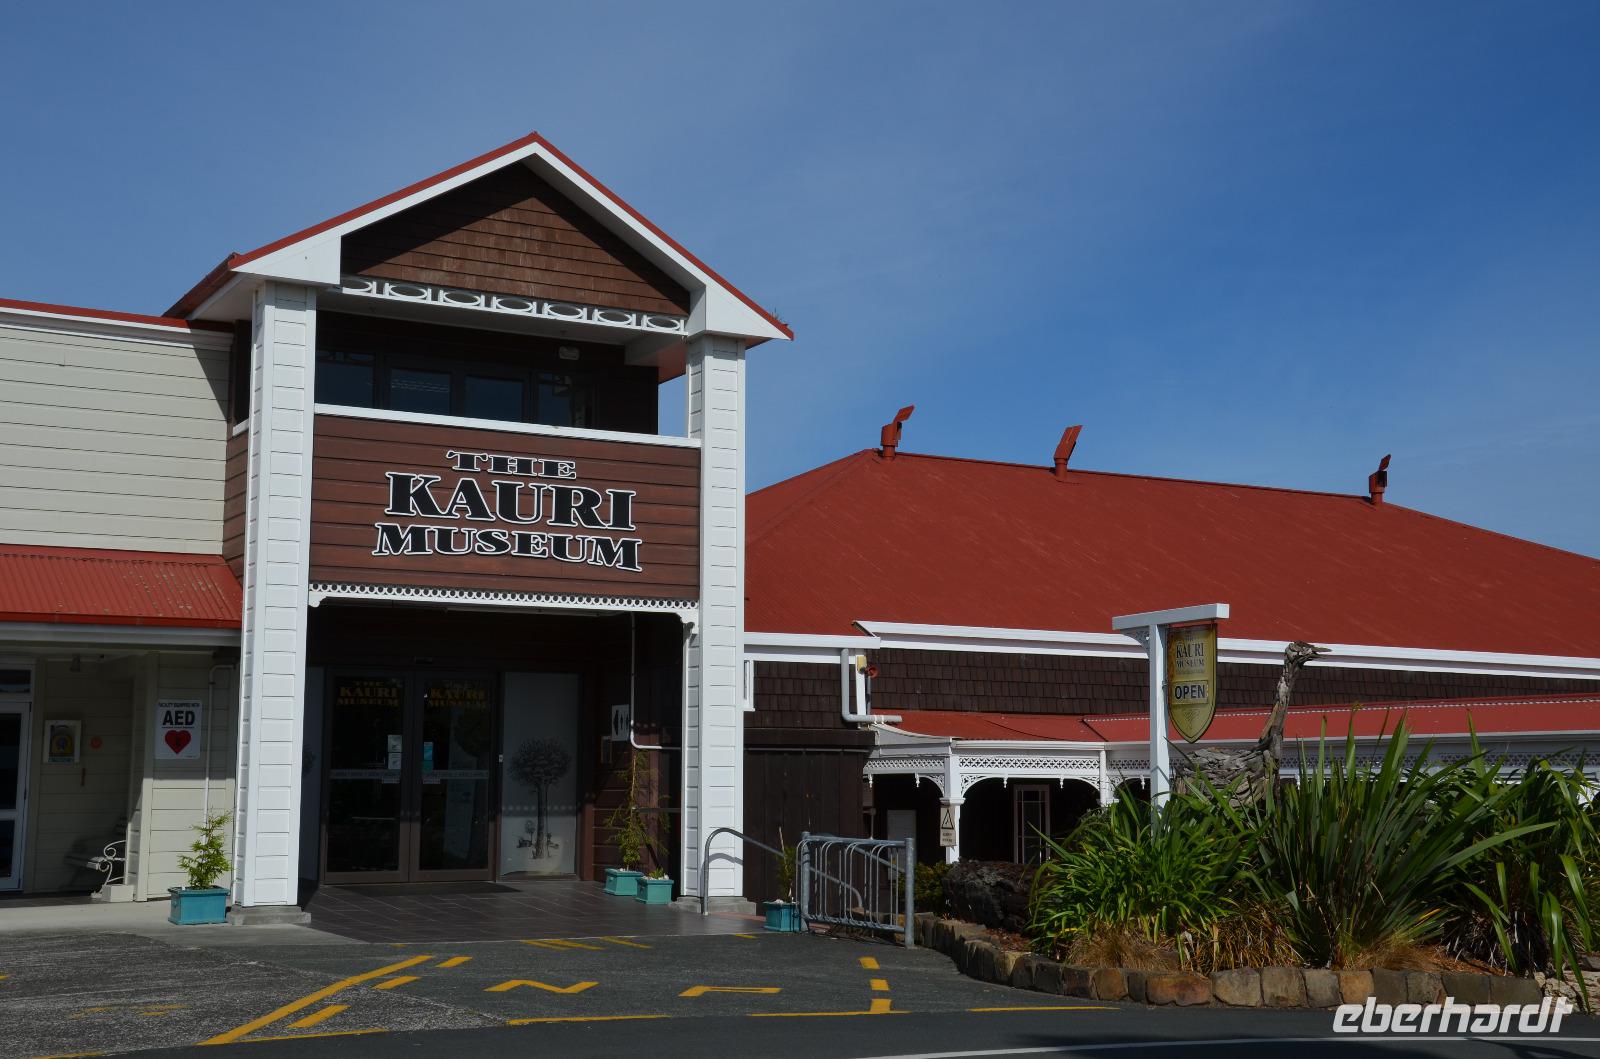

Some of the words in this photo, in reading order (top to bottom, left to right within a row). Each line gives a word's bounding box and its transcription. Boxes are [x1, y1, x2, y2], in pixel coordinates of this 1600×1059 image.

[446, 450, 577, 479] THE
[384, 472, 636, 531] KAURI
[372, 523, 643, 572] MUSEUM
[1176, 642, 1204, 658] KAURI
[1176, 659, 1204, 668] MUSEUM
[339, 687, 398, 697] KAURI
[1174, 684, 1205, 699] OPEN
[336, 697, 399, 706] MUSEUM
[162, 710, 195, 725] AED
